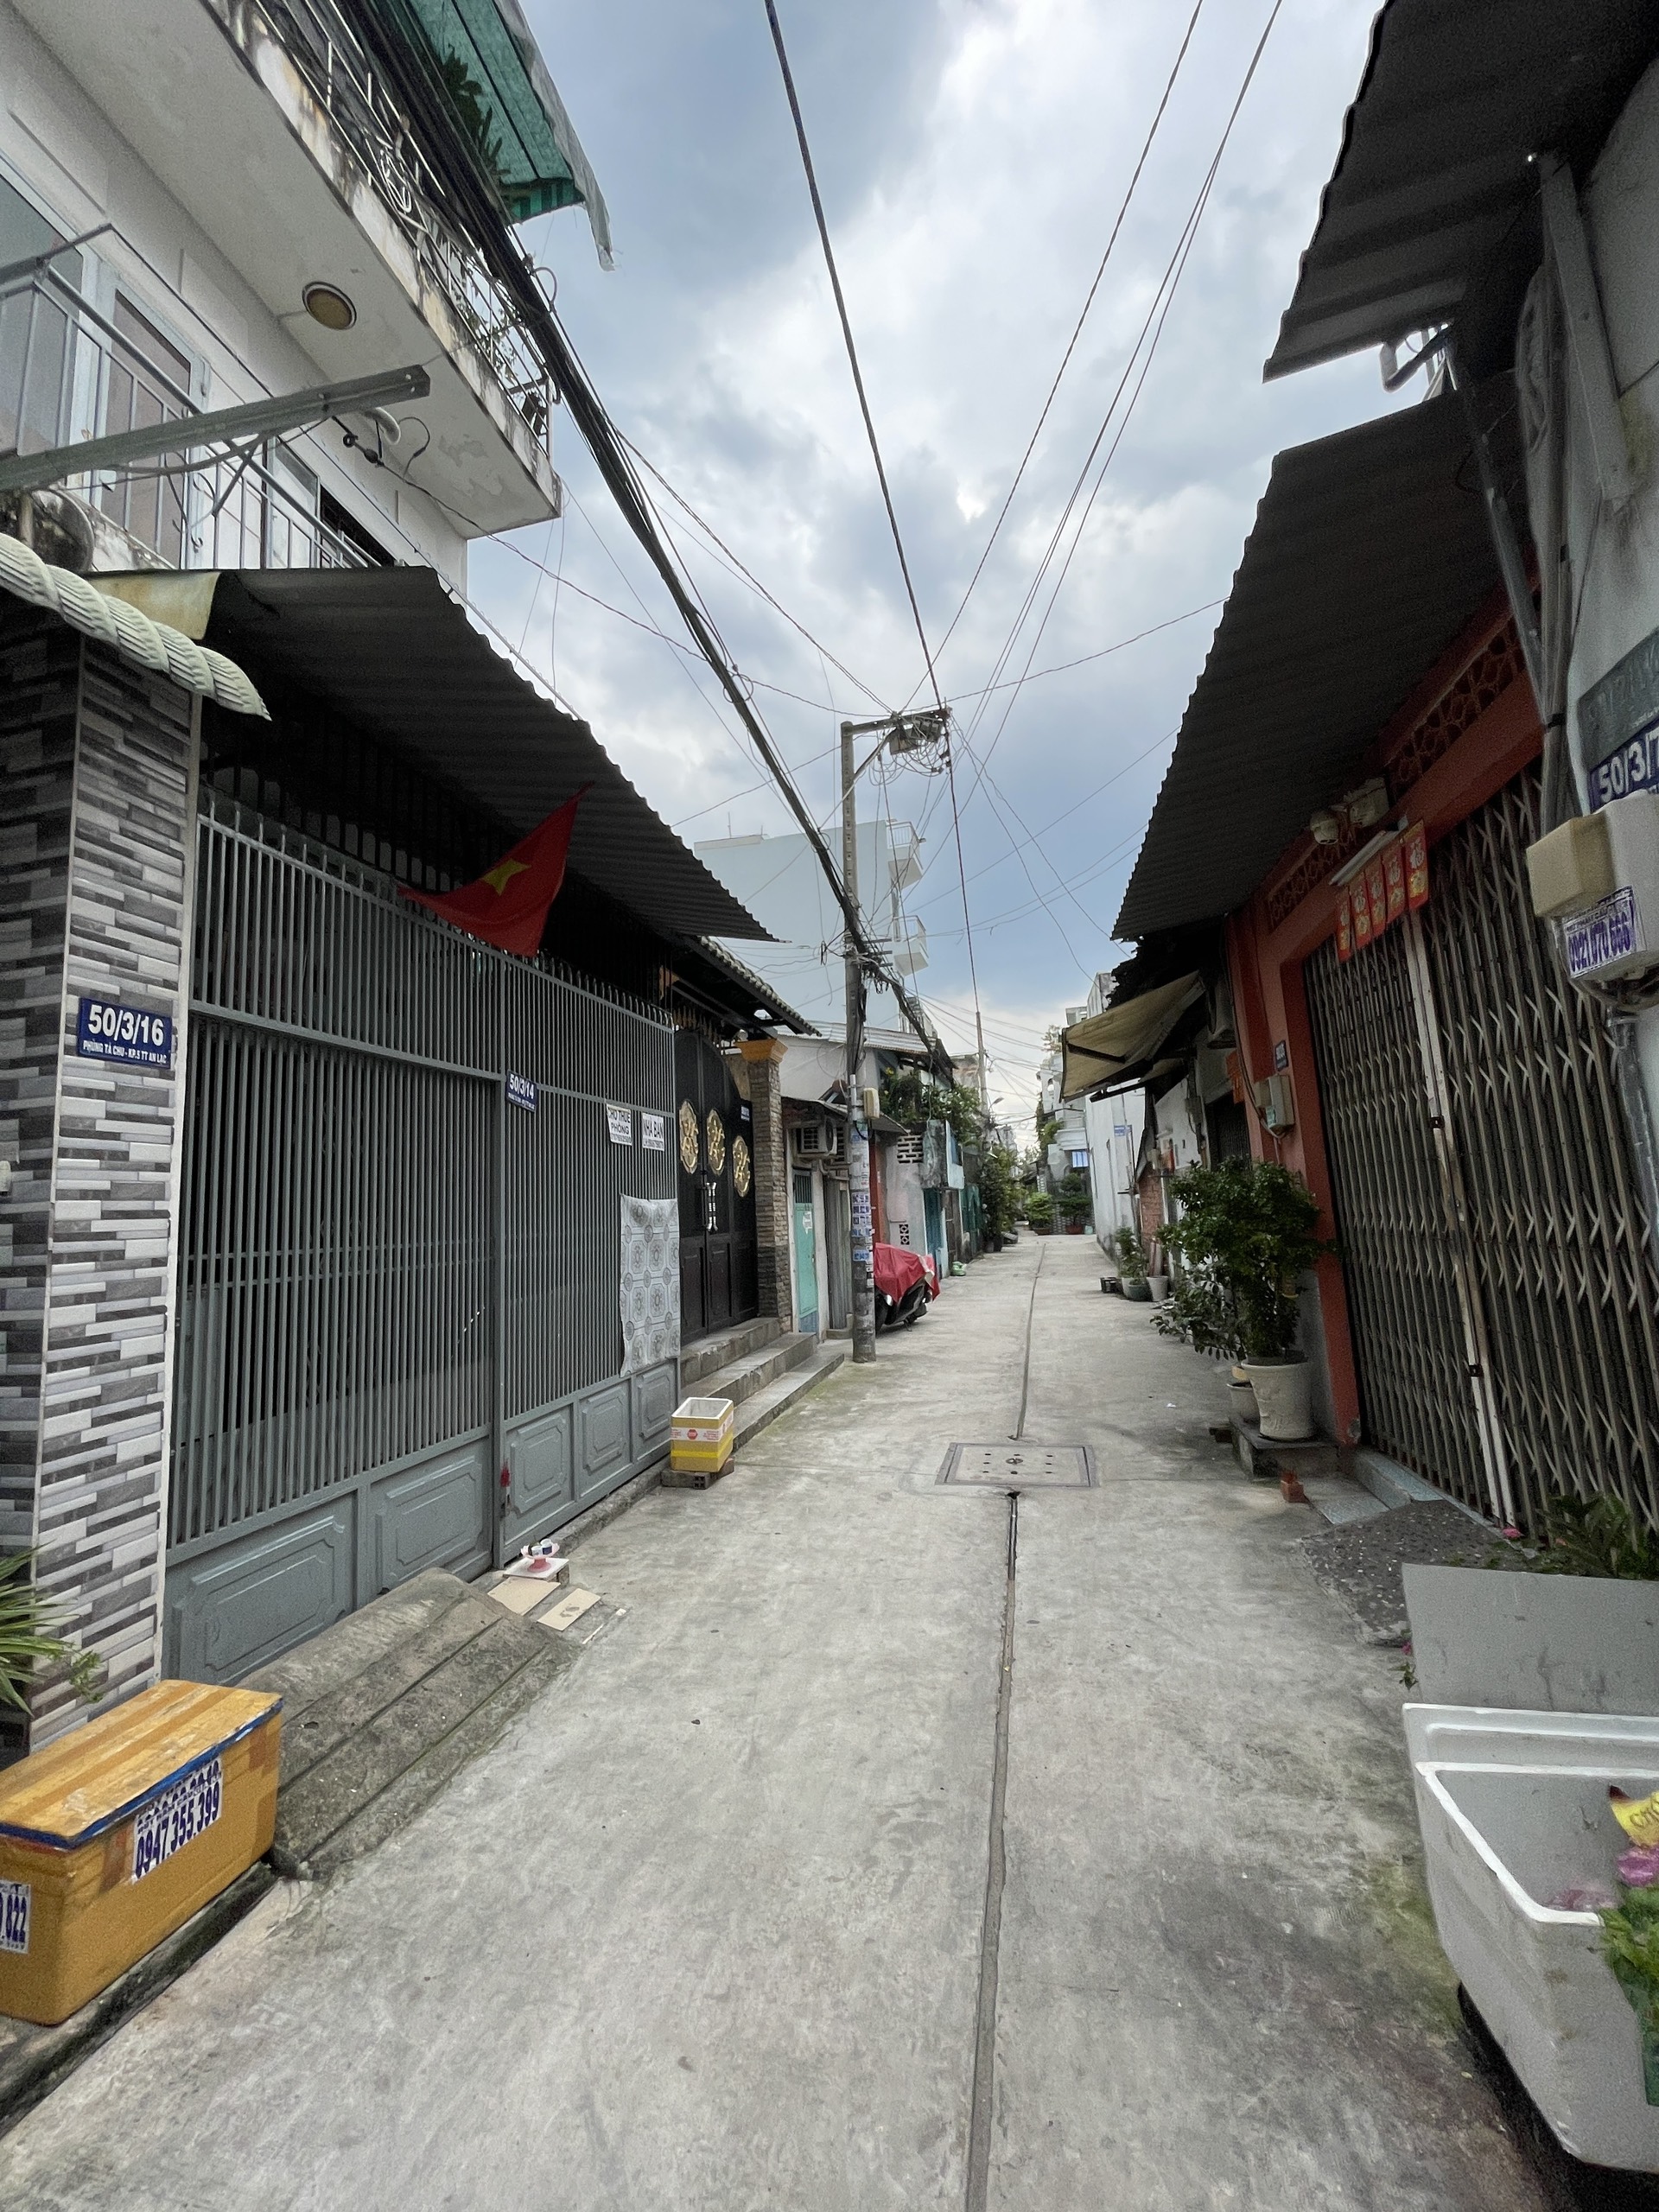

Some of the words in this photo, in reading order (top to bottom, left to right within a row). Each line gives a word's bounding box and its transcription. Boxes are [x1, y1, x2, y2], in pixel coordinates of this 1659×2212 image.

[88, 1004, 164, 1046] 50/3/16
[510, 1073, 535, 1099] 50/3/14
[136, 1782, 219, 1879] 0947.355.399
